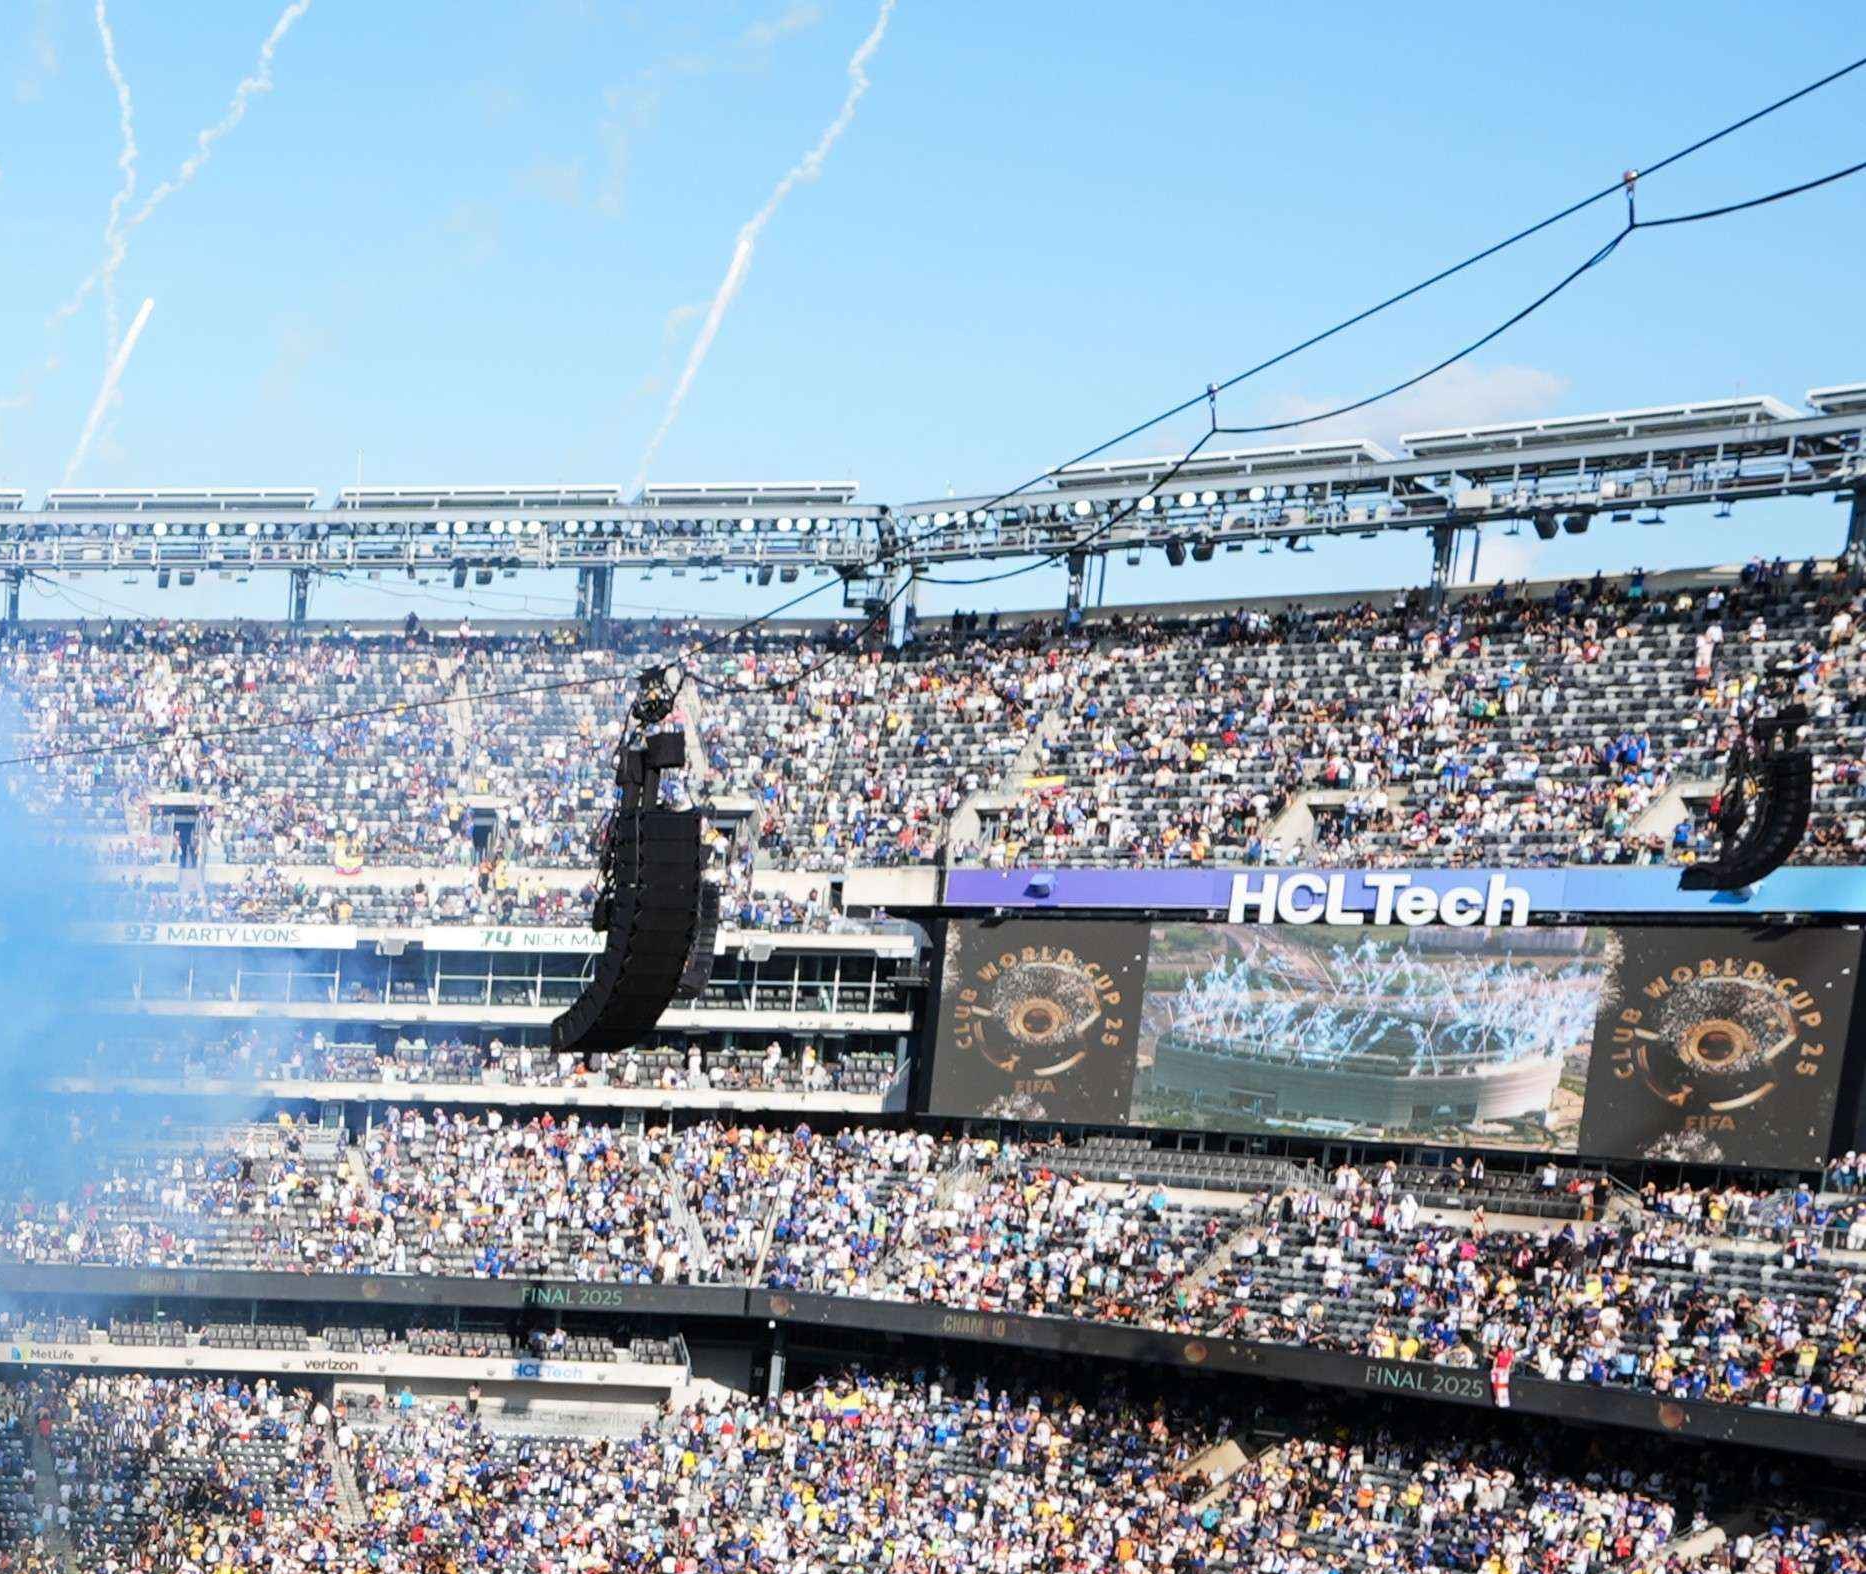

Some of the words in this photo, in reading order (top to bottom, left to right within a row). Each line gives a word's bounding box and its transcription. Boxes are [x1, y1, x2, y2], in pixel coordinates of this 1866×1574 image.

[1228, 873, 1530, 926] HCLTech
[124, 924, 158, 942] 93
[167, 927, 238, 942] MARTY
[243, 927, 301, 943] LYONS
[480, 930, 513, 947] 74
[524, 931, 565, 947] NICK
[976, 946, 1075, 983] WORLD
[1642, 958, 1766, 999] WORLD
[1084, 962, 1121, 1005] CUP
[1774, 977, 1822, 1028] CUP
[954, 988, 978, 1050] CLUB
[1101, 1017, 1124, 1046] 25
[1611, 1007, 1643, 1080] CLUB
[1795, 1042, 1826, 1076] 25
[1013, 1080, 1056, 1094] FIFA
[1685, 1115, 1737, 1131] FIFA
[521, 1286, 574, 1305] FINAL
[579, 1289, 623, 1306] 2025
[30, 1348, 75, 1360] MetLife
[304, 1358, 359, 1372] verizon
[512, 1362, 582, 1379] HCLTech
[1365, 1365, 1429, 1391] FINAL
[1431, 1374, 1484, 1398] 2025
